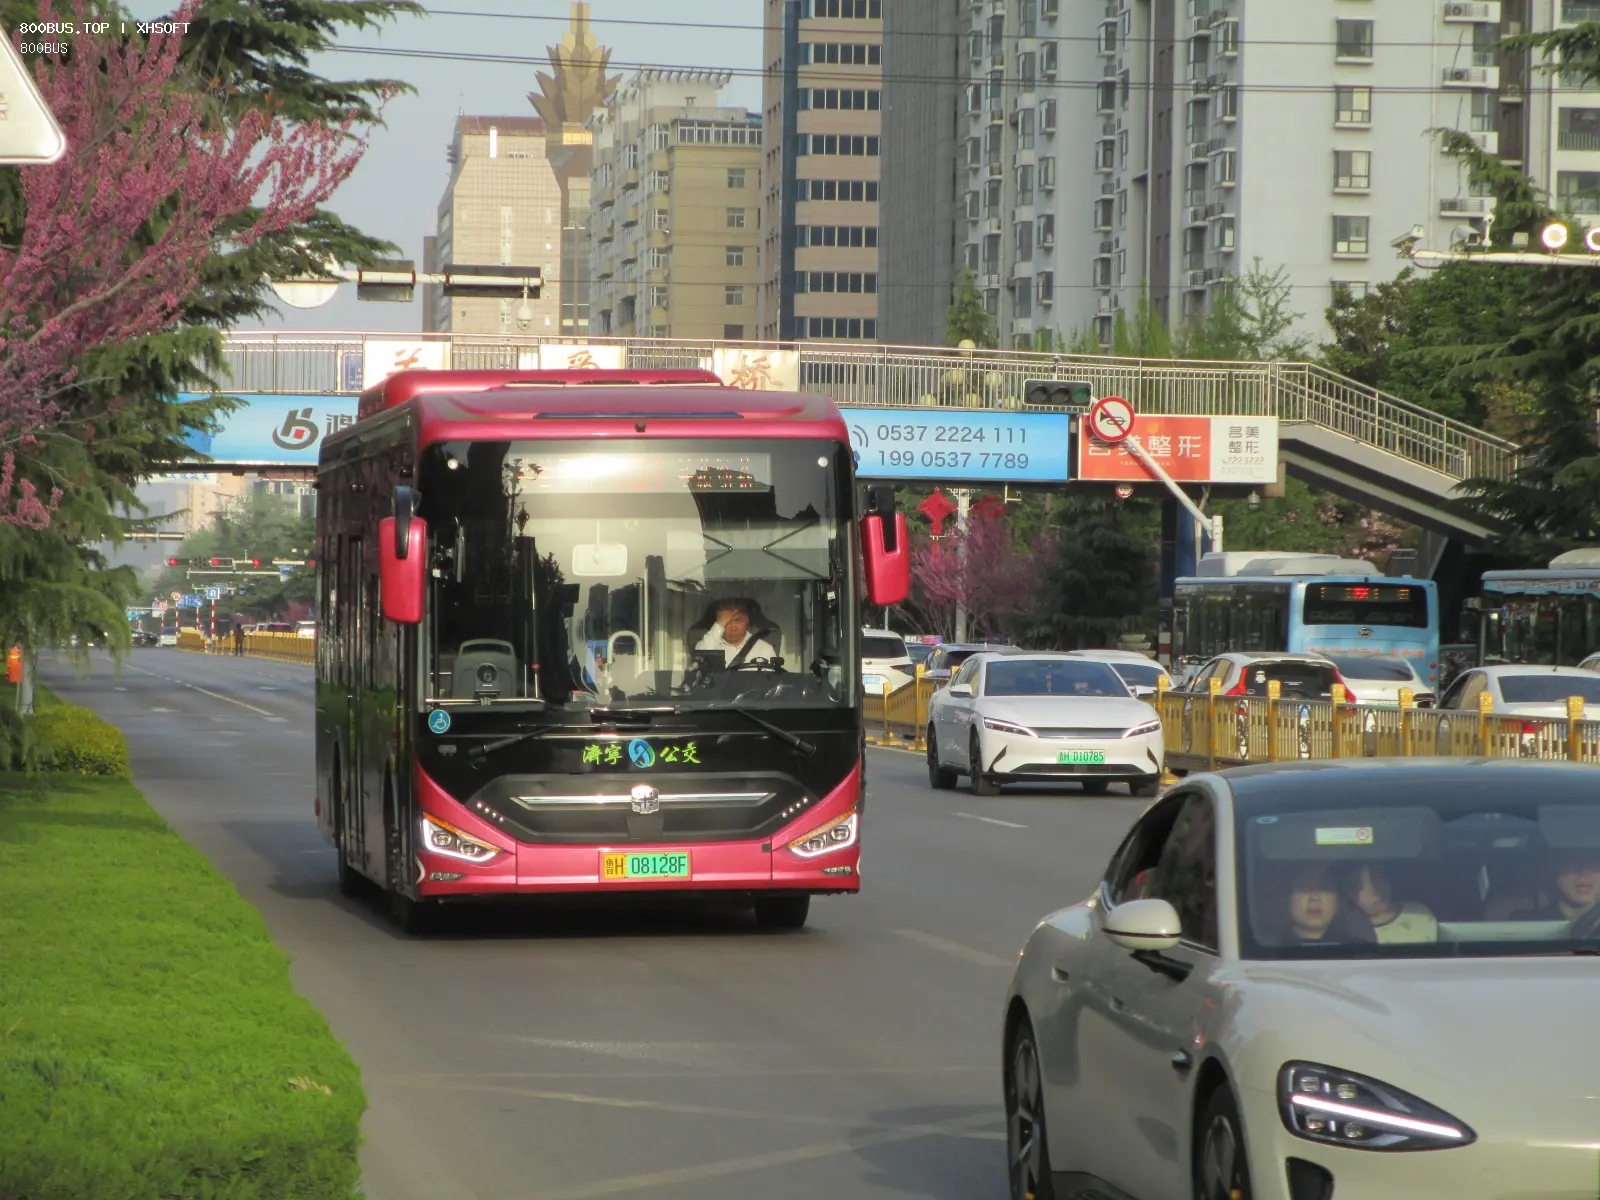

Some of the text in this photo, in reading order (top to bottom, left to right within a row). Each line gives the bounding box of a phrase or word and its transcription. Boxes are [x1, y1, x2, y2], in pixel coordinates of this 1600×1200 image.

[877, 424, 1028, 444] 0537 2224 111
[879, 450, 1029, 469] 199 0537 7789
[660, 742, 701, 764] 公交
[631, 856, 686, 875] 08128F
